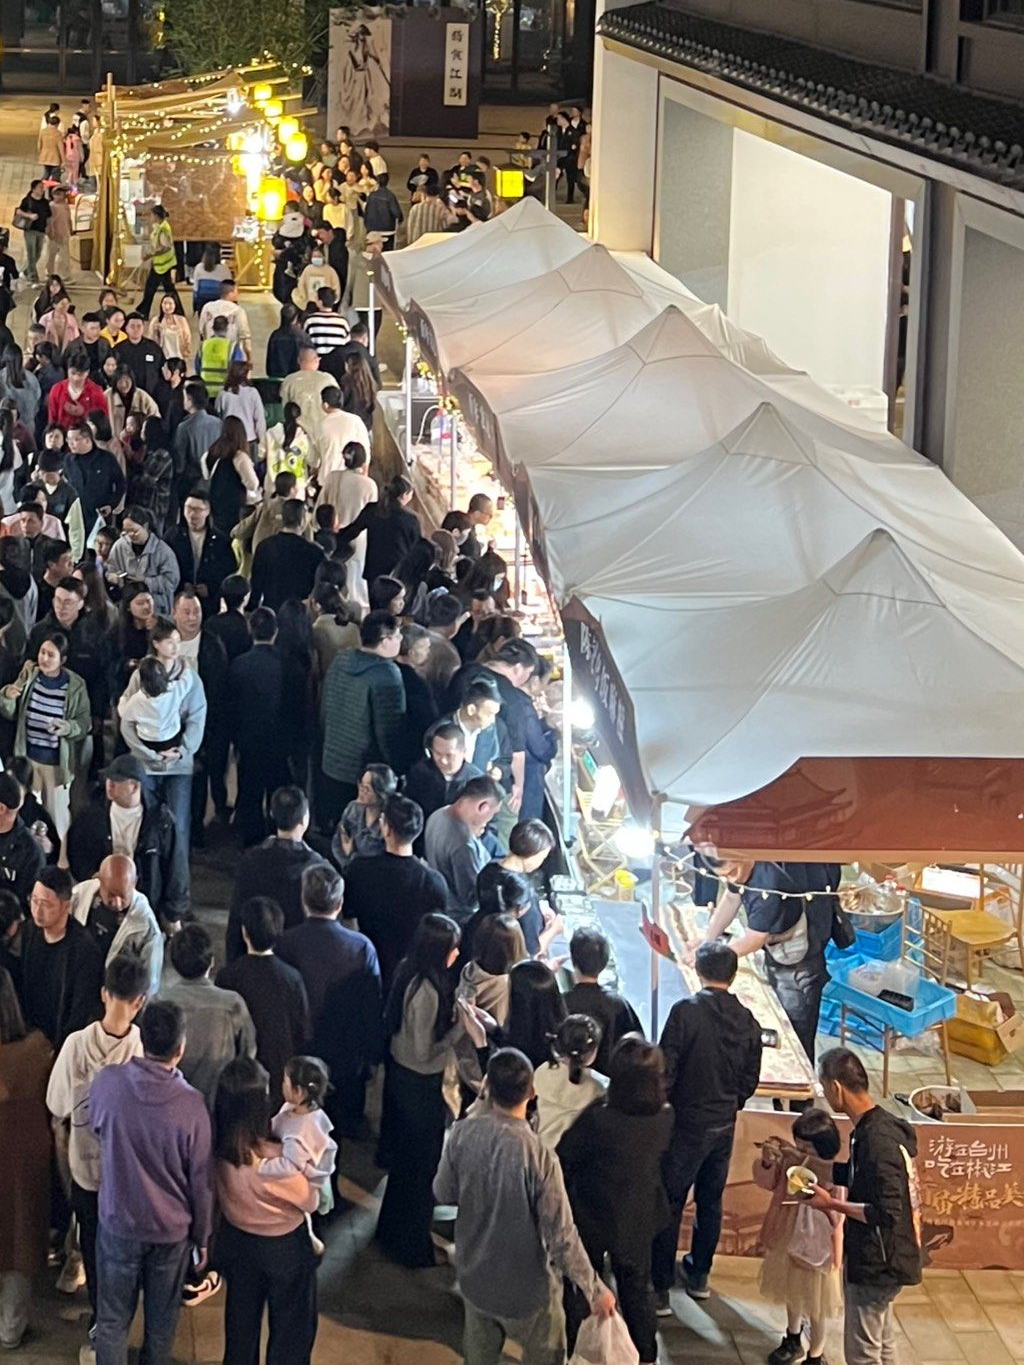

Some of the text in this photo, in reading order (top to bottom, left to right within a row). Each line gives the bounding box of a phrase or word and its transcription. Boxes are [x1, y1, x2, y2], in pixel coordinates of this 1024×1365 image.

[929, 1135, 1008, 1161] 游在台州
[924, 1155, 1013, 1179] 吃在椒江
